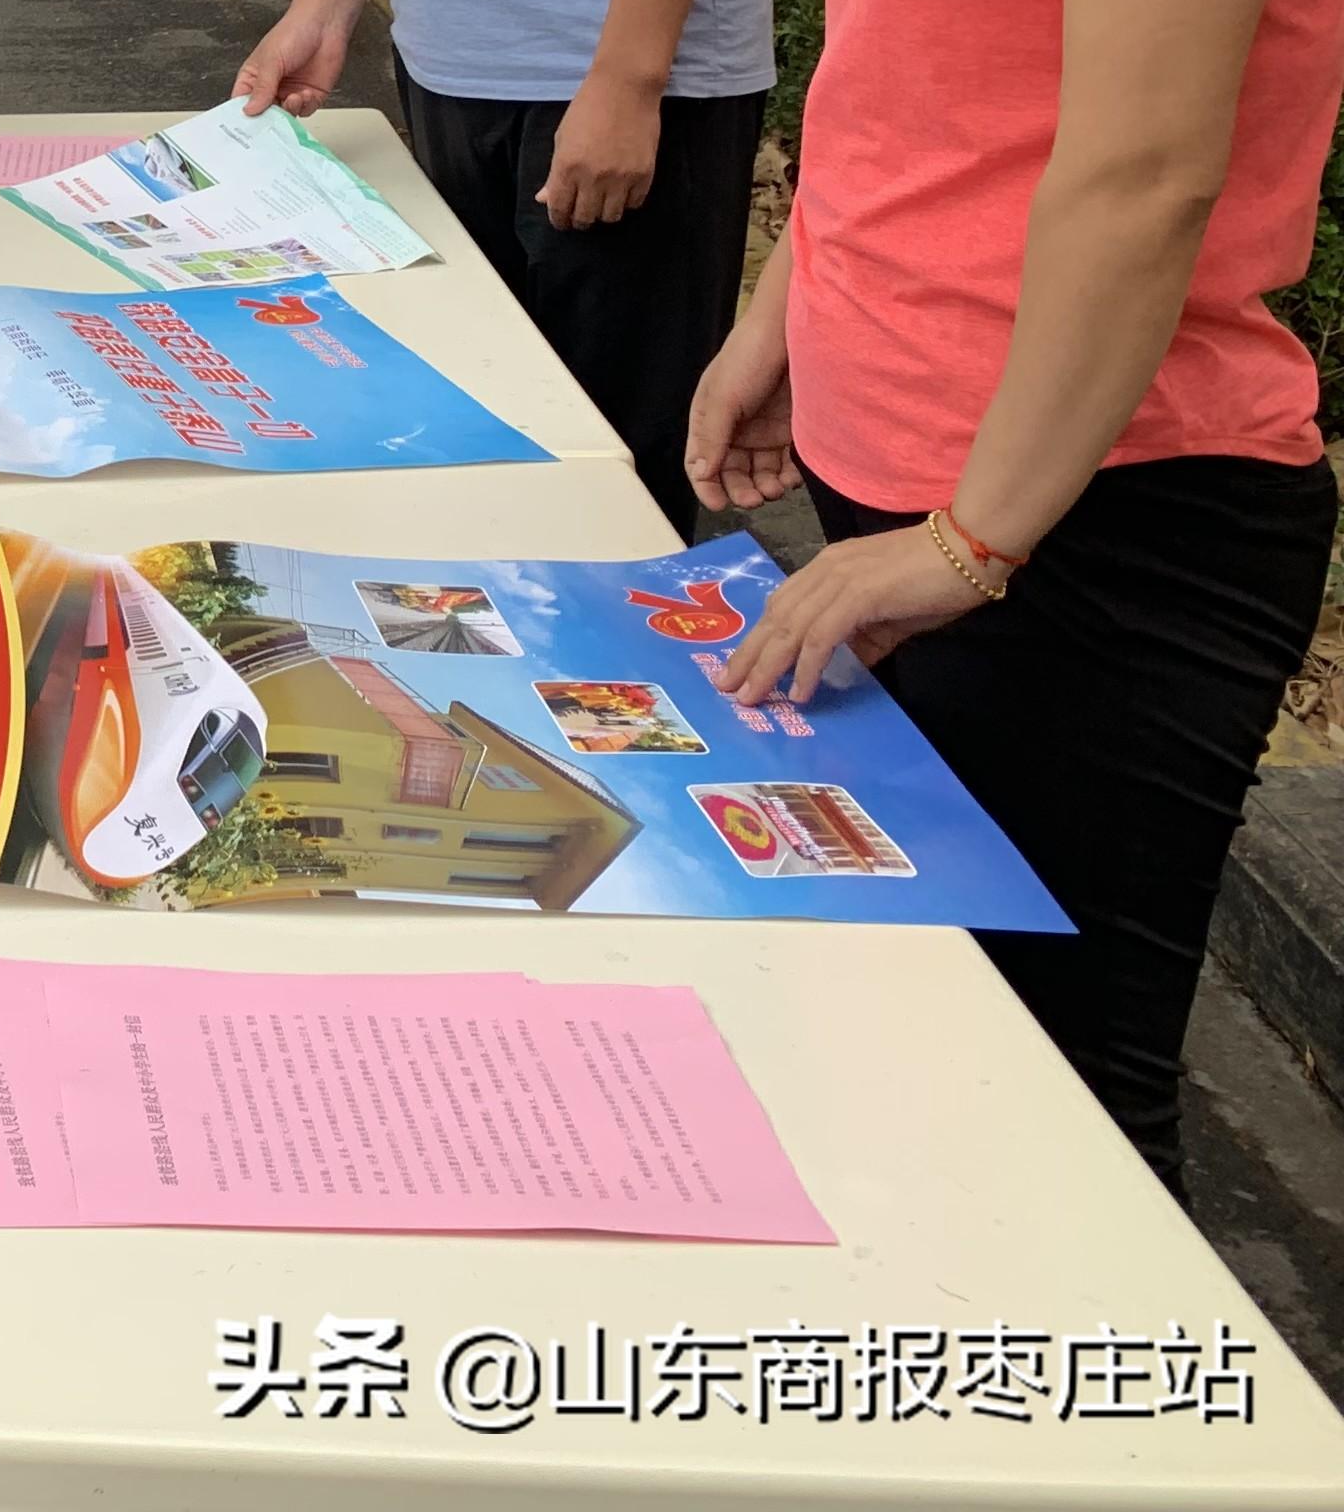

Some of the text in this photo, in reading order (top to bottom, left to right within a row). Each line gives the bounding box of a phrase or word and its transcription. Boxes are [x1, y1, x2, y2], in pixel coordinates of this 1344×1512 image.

[53, 310, 244, 455] 护路责任重于泰山
[114, 301, 317, 442] 铁路安全高于一切
[122, 1013, 181, 1187] 致铁路沿线人民群众及中小学生的一封信
